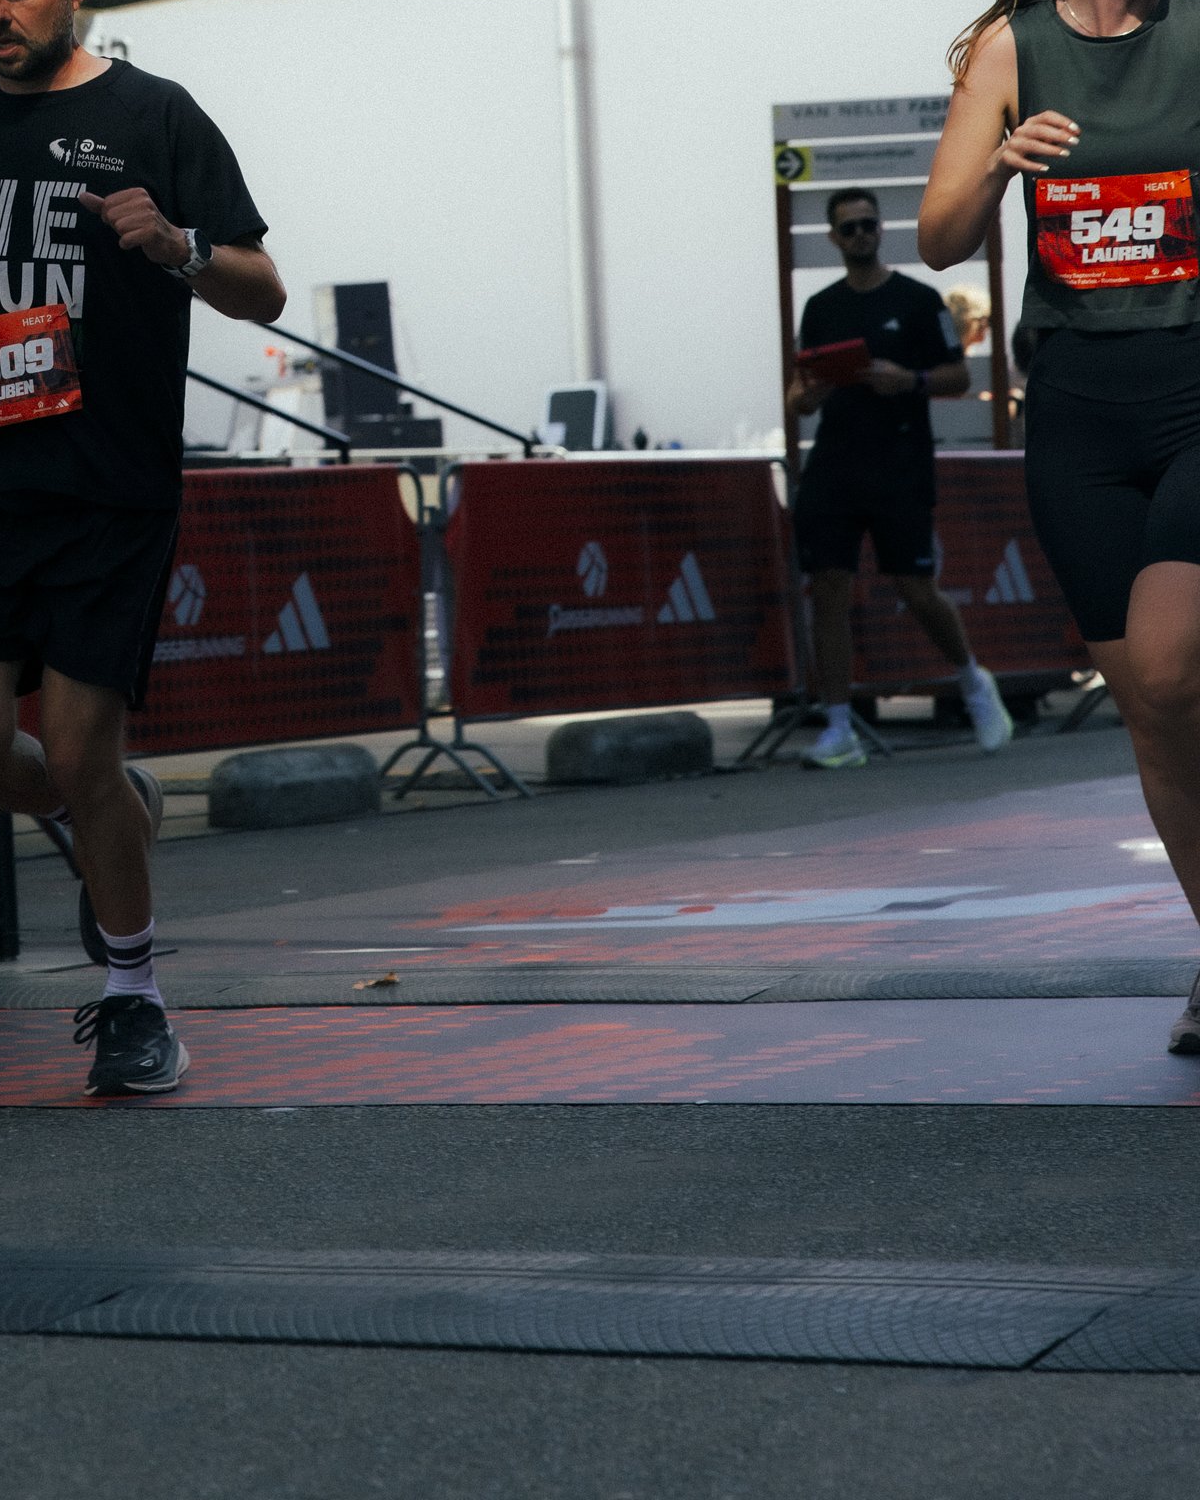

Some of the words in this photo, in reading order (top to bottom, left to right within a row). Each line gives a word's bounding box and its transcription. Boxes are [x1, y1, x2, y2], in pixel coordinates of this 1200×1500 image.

[791, 106, 829, 118] VAN
[838, 103, 898, 116] NELLE
[77, 153, 125, 166] MARATHON
[76, 160, 124, 173] ROTTERDAM
[1144, 182, 1169, 192] HEAT
[1170, 181, 1175, 189] 1
[1070, 205, 1166, 245] 549
[1081, 244, 1156, 264] LAUREN
[22, 316, 45, 327] HEAT
[46, 314, 53, 323] 2
